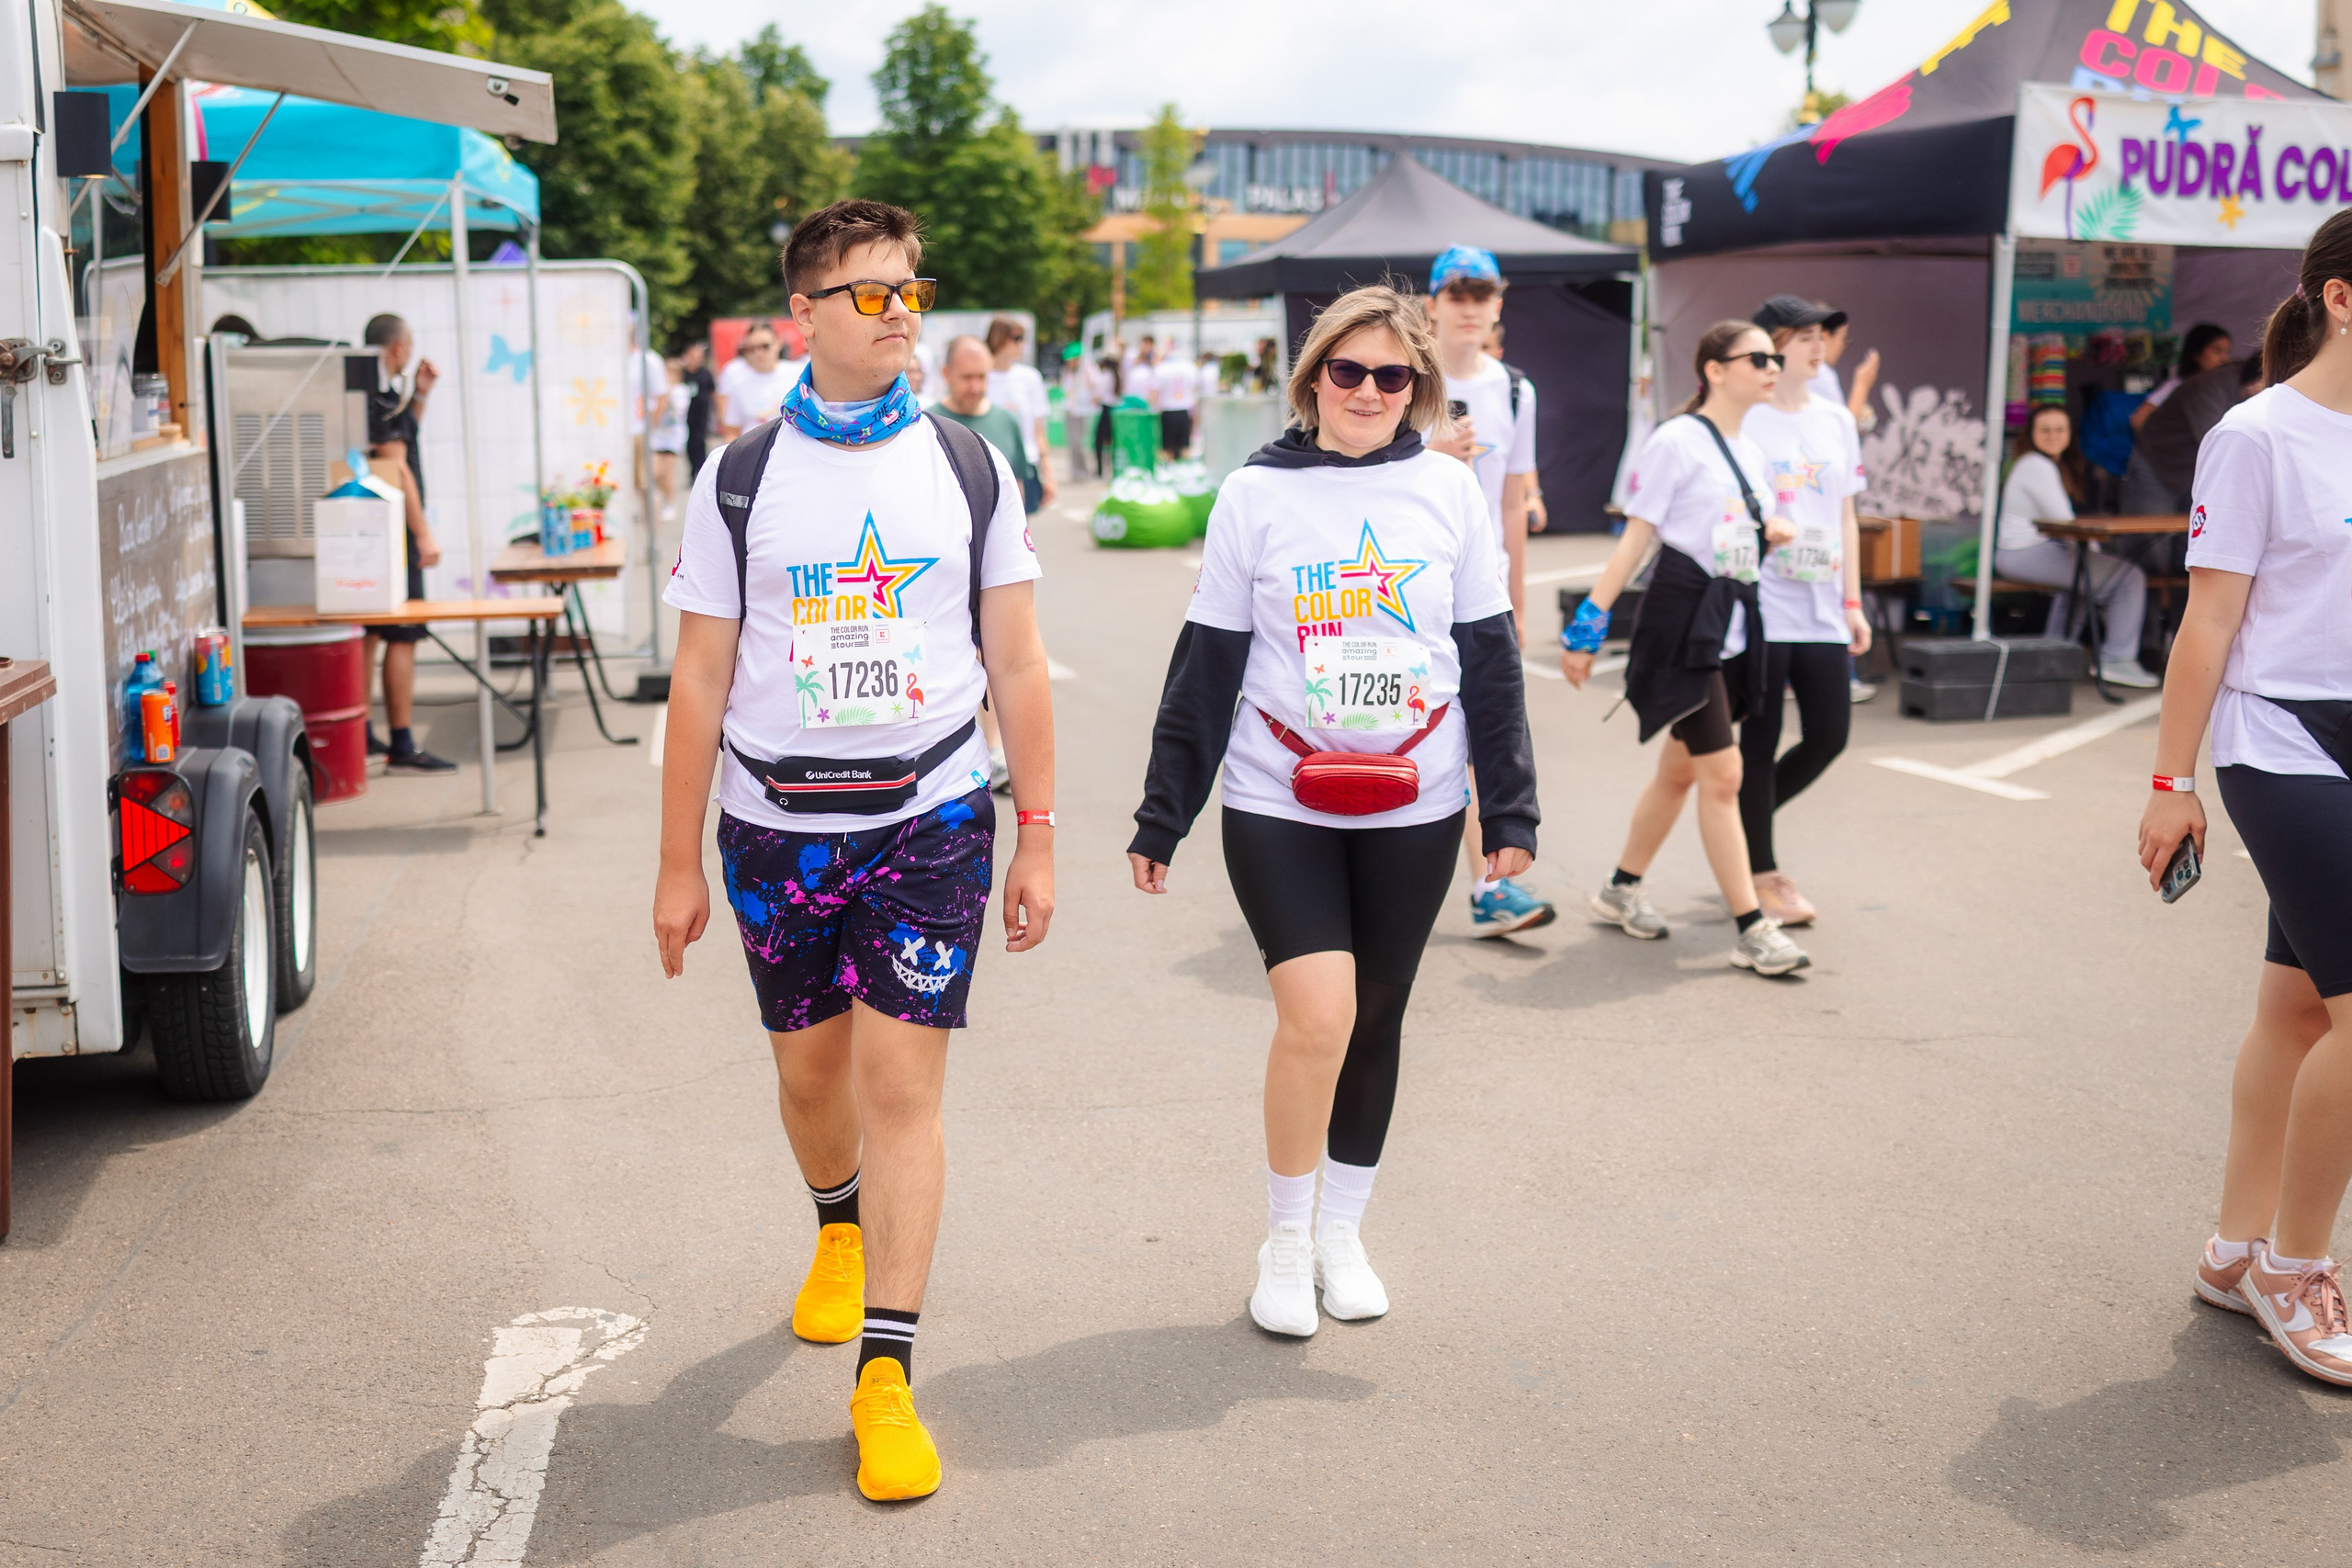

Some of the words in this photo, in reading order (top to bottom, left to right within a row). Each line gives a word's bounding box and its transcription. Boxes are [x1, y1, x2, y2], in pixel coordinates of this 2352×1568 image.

[2120, 124, 2264, 200] PUDRĂ
[872, 402, 889, 422] THE
[786, 563, 833, 597] THE
[1291, 561, 1337, 593] THE
[1294, 588, 1372, 624] COLOR
[830, 633, 869, 641] amazing
[841, 626, 857, 634] COLOR
[828, 660, 899, 700] 17236
[1339, 672, 1402, 706] 17235
[815, 770, 851, 779] UniCredit
[852, 770, 872, 779] Bank
